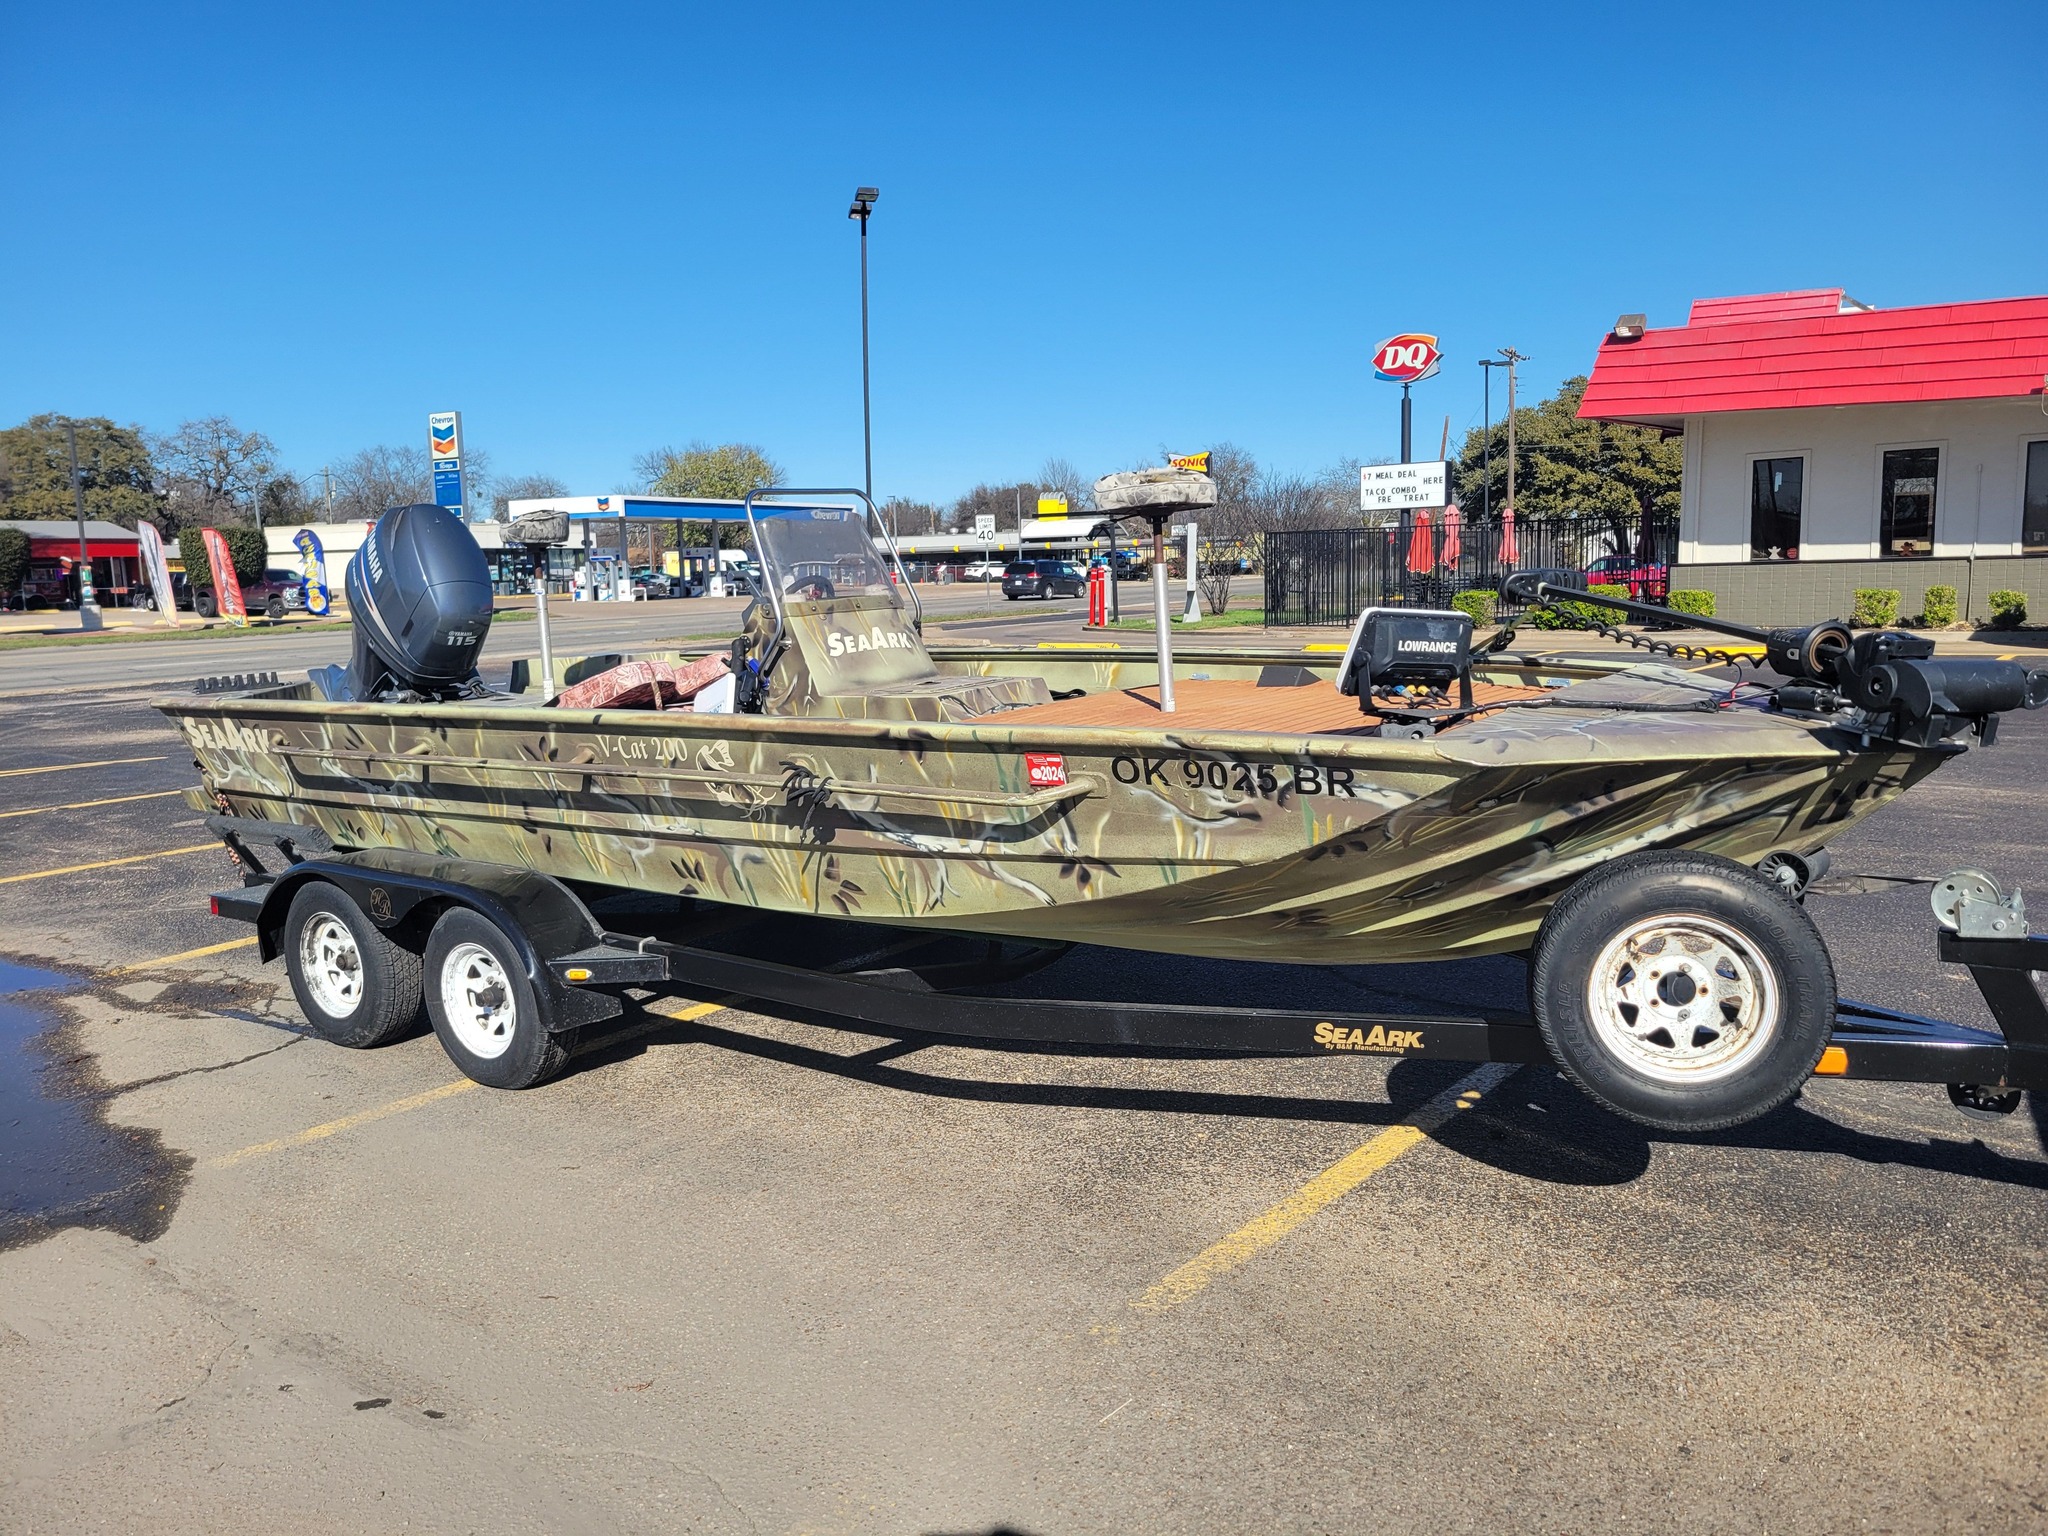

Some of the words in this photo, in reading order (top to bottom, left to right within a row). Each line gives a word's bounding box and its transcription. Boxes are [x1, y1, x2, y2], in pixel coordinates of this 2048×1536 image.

[1382, 342, 1428, 370] DQ
[431, 416, 454, 425] Chevron
[1172, 457, 1206, 468] SONIC
[1376, 472, 1394, 480] MEAL
[1398, 470, 1417, 478] DEAL
[1423, 477, 1444, 485] HERE
[1365, 488, 1386, 496] TACO
[1391, 486, 1417, 495] COMBO
[1378, 495, 1392, 503] FRE
[1404, 493, 1430, 502] TREAT
[978, 530, 994, 541] 40
[447, 635, 478, 646] 115
[1398, 640, 1458, 653] LOWRANCE
[595, 734, 649, 760] V-Cat
[651, 737, 688, 762] 200
[1040, 765, 1065, 781] 2024
[1111, 755, 1171, 787] OK
[1183, 760, 1279, 793] 9025
[1294, 765, 1359, 798] BR
[1744, 904, 1804, 964] SPORT
[1794, 976, 1815, 1042] TRAIL
[1558, 980, 1611, 1082] CARLISLE
[1325, 1042, 1334, 1050] By
[1354, 1044, 1405, 1055] Manufacturing
